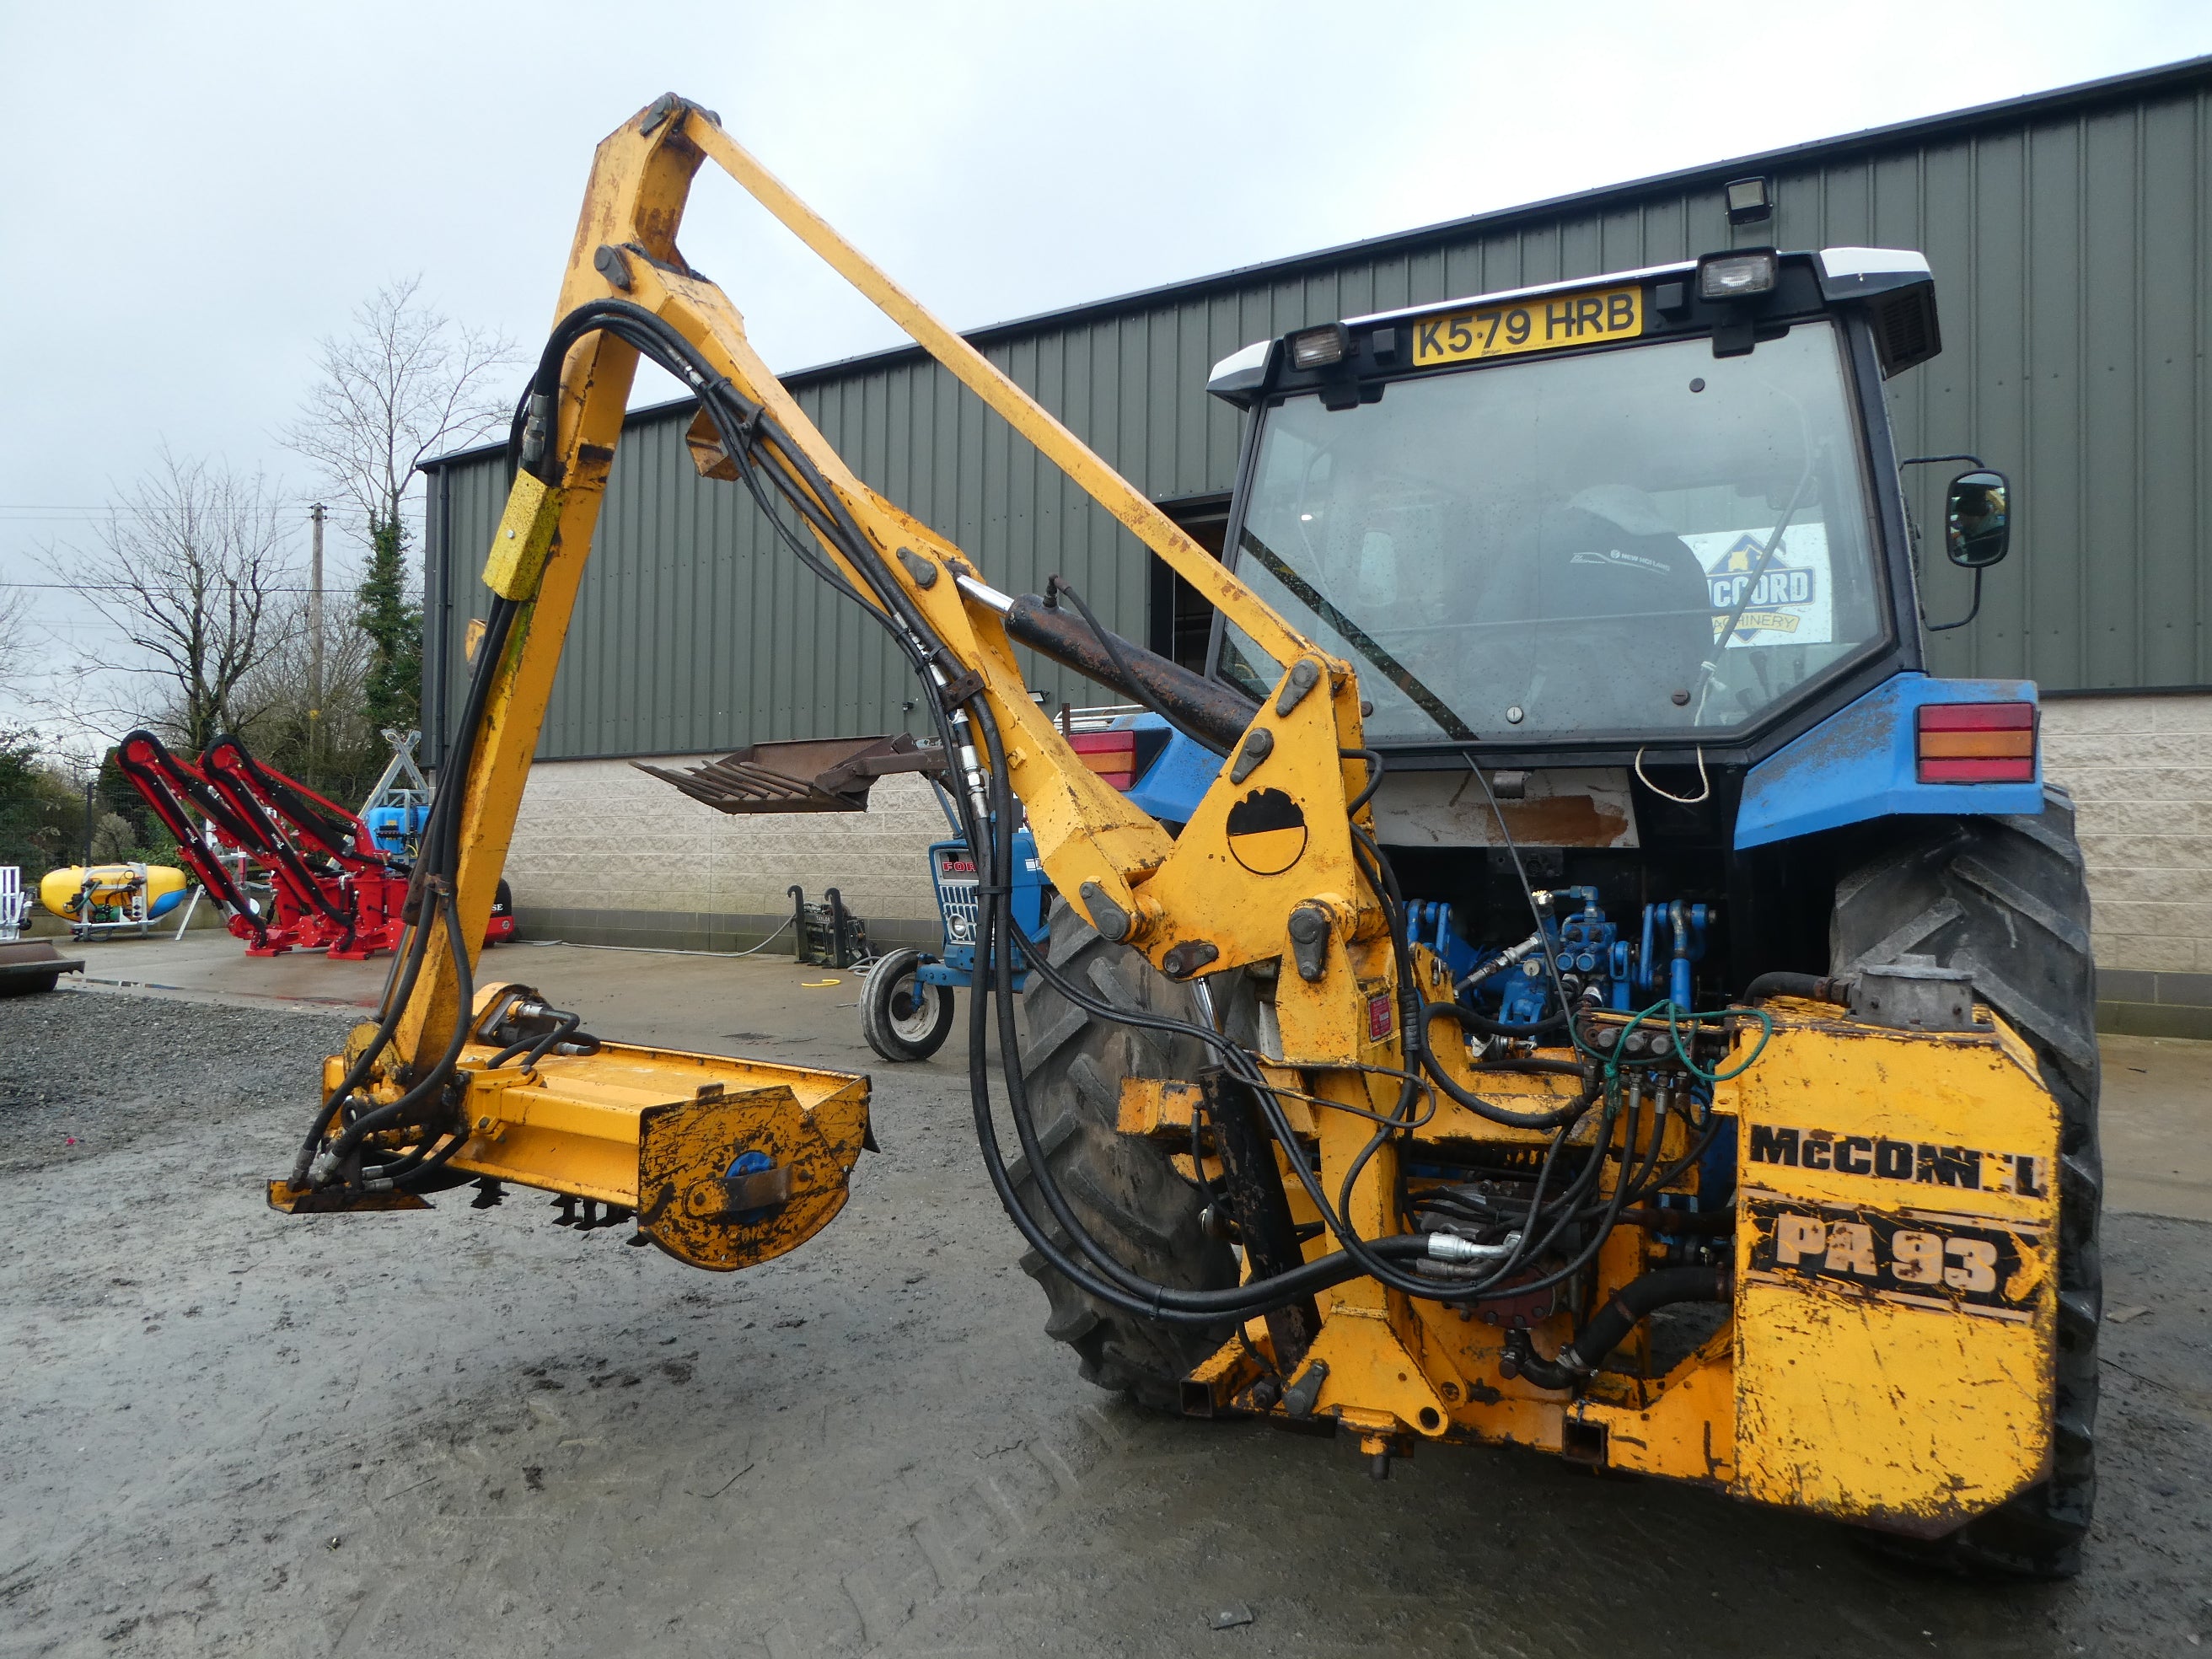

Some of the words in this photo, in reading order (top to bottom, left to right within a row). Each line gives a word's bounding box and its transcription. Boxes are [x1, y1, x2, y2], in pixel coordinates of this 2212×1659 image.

[1419, 309, 1532, 358] K579
[1545, 294, 1635, 341] HRB
[942, 862, 977, 872] FOR
[1777, 1213, 1878, 1276] PA
[1892, 1230, 1997, 1292] 93
